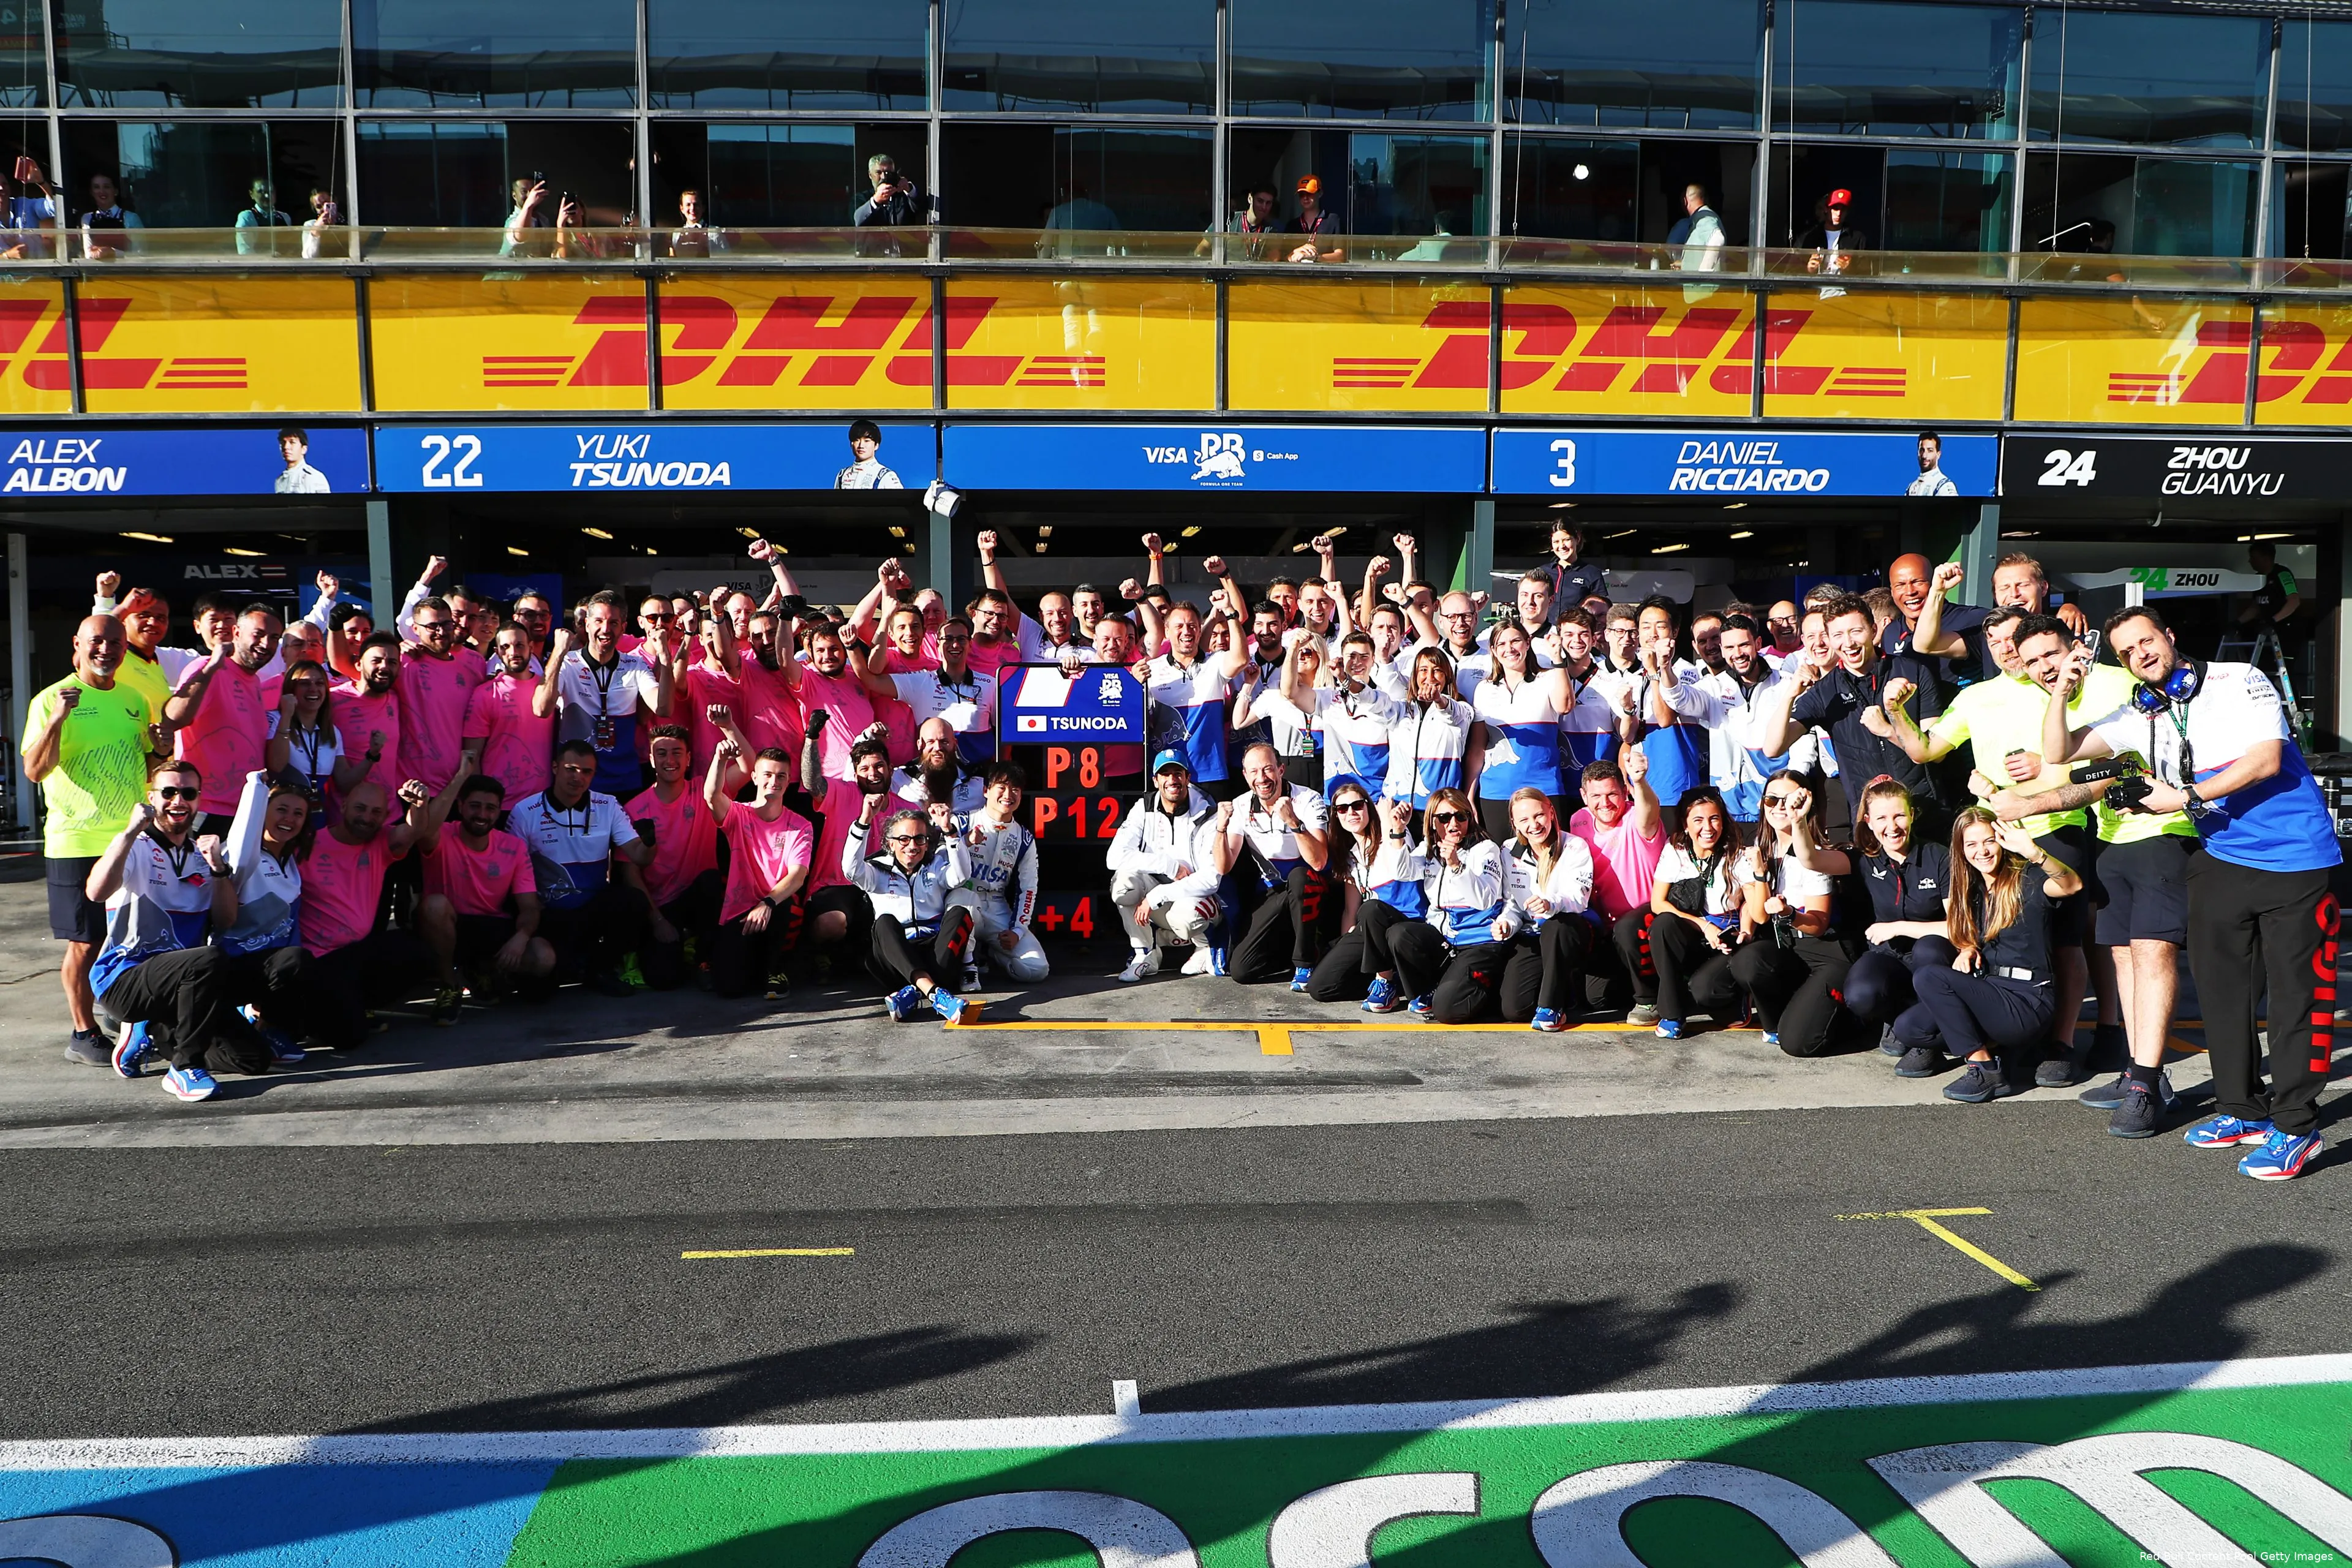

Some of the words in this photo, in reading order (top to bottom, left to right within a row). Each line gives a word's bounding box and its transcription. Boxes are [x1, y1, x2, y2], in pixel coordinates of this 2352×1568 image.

[567, 295, 1024, 386] DHL
[1411, 302, 1834, 396] DHL
[2177, 320, 2352, 404] D
[7, 439, 102, 464] ALEX
[576, 434, 651, 459] YUKI
[1142, 447, 1188, 464] VISA
[1284, 453, 1298, 461] App
[1676, 441, 1784, 466] DANIEL
[2167, 447, 2252, 470] ZHOU
[421, 435, 483, 487] 22
[1550, 439, 1576, 487] 3
[2037, 449, 2097, 486] 24
[2, 467, 127, 492] ALBON
[569, 462, 731, 487] TSUNODA
[1668, 468, 1830, 492] RICCIARDO
[2161, 472, 2285, 496] GUANYU
[184, 564, 258, 579] ALEX
[2129, 567, 2169, 592] 24
[2174, 573, 2219, 587] ZHOU
[726, 581, 752, 591] VISA
[1684, 671, 1697, 679] VISA
[2244, 675, 2267, 685] VISA
[1050, 717, 1128, 730] TSUNODA
[2085, 769, 2111, 781] DEITY
[970, 861, 1009, 883] VISA
[1022, 890, 1033, 915] ORLEN
